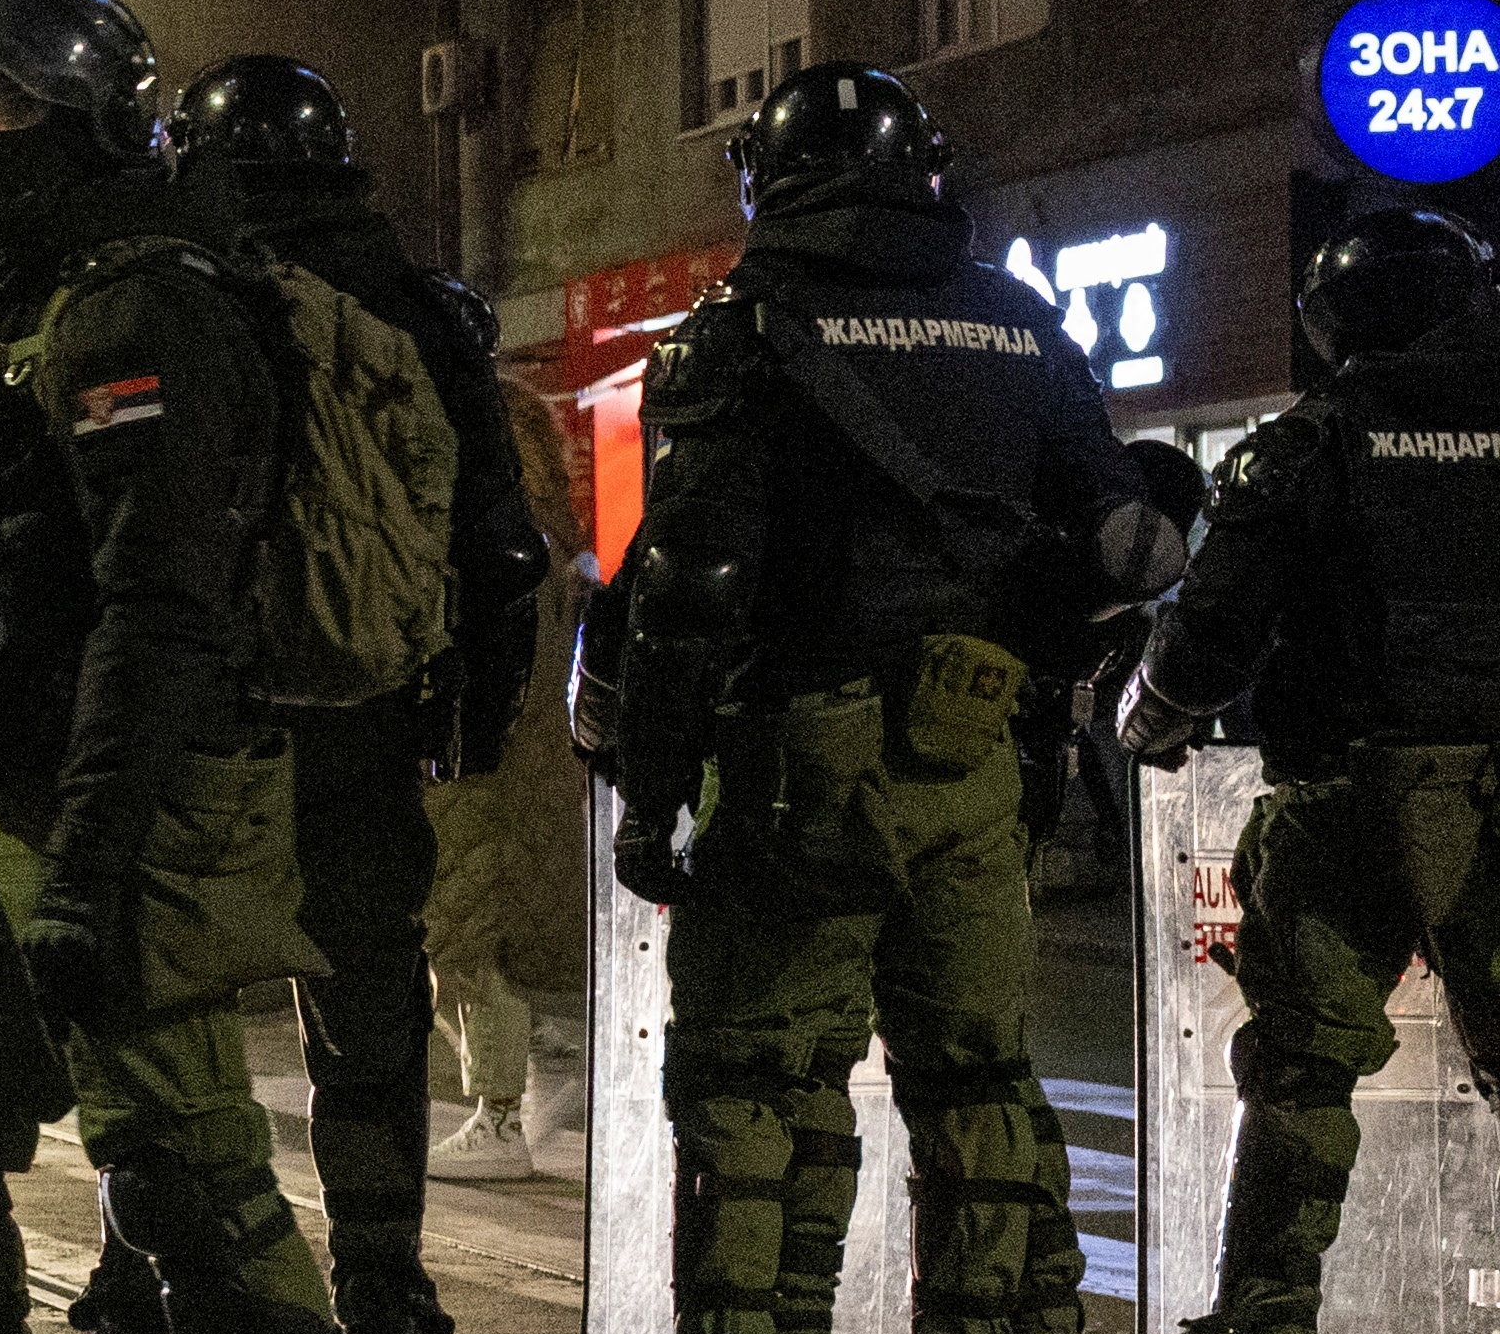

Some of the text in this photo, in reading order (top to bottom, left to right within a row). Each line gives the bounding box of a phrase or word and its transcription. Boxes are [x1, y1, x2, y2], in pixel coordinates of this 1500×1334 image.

[1349, 29, 1500, 77] ЗОНА
[1368, 87, 1484, 133] 24x7
[816, 315, 1041, 357] ЖАНДАРМЕРИЈА
